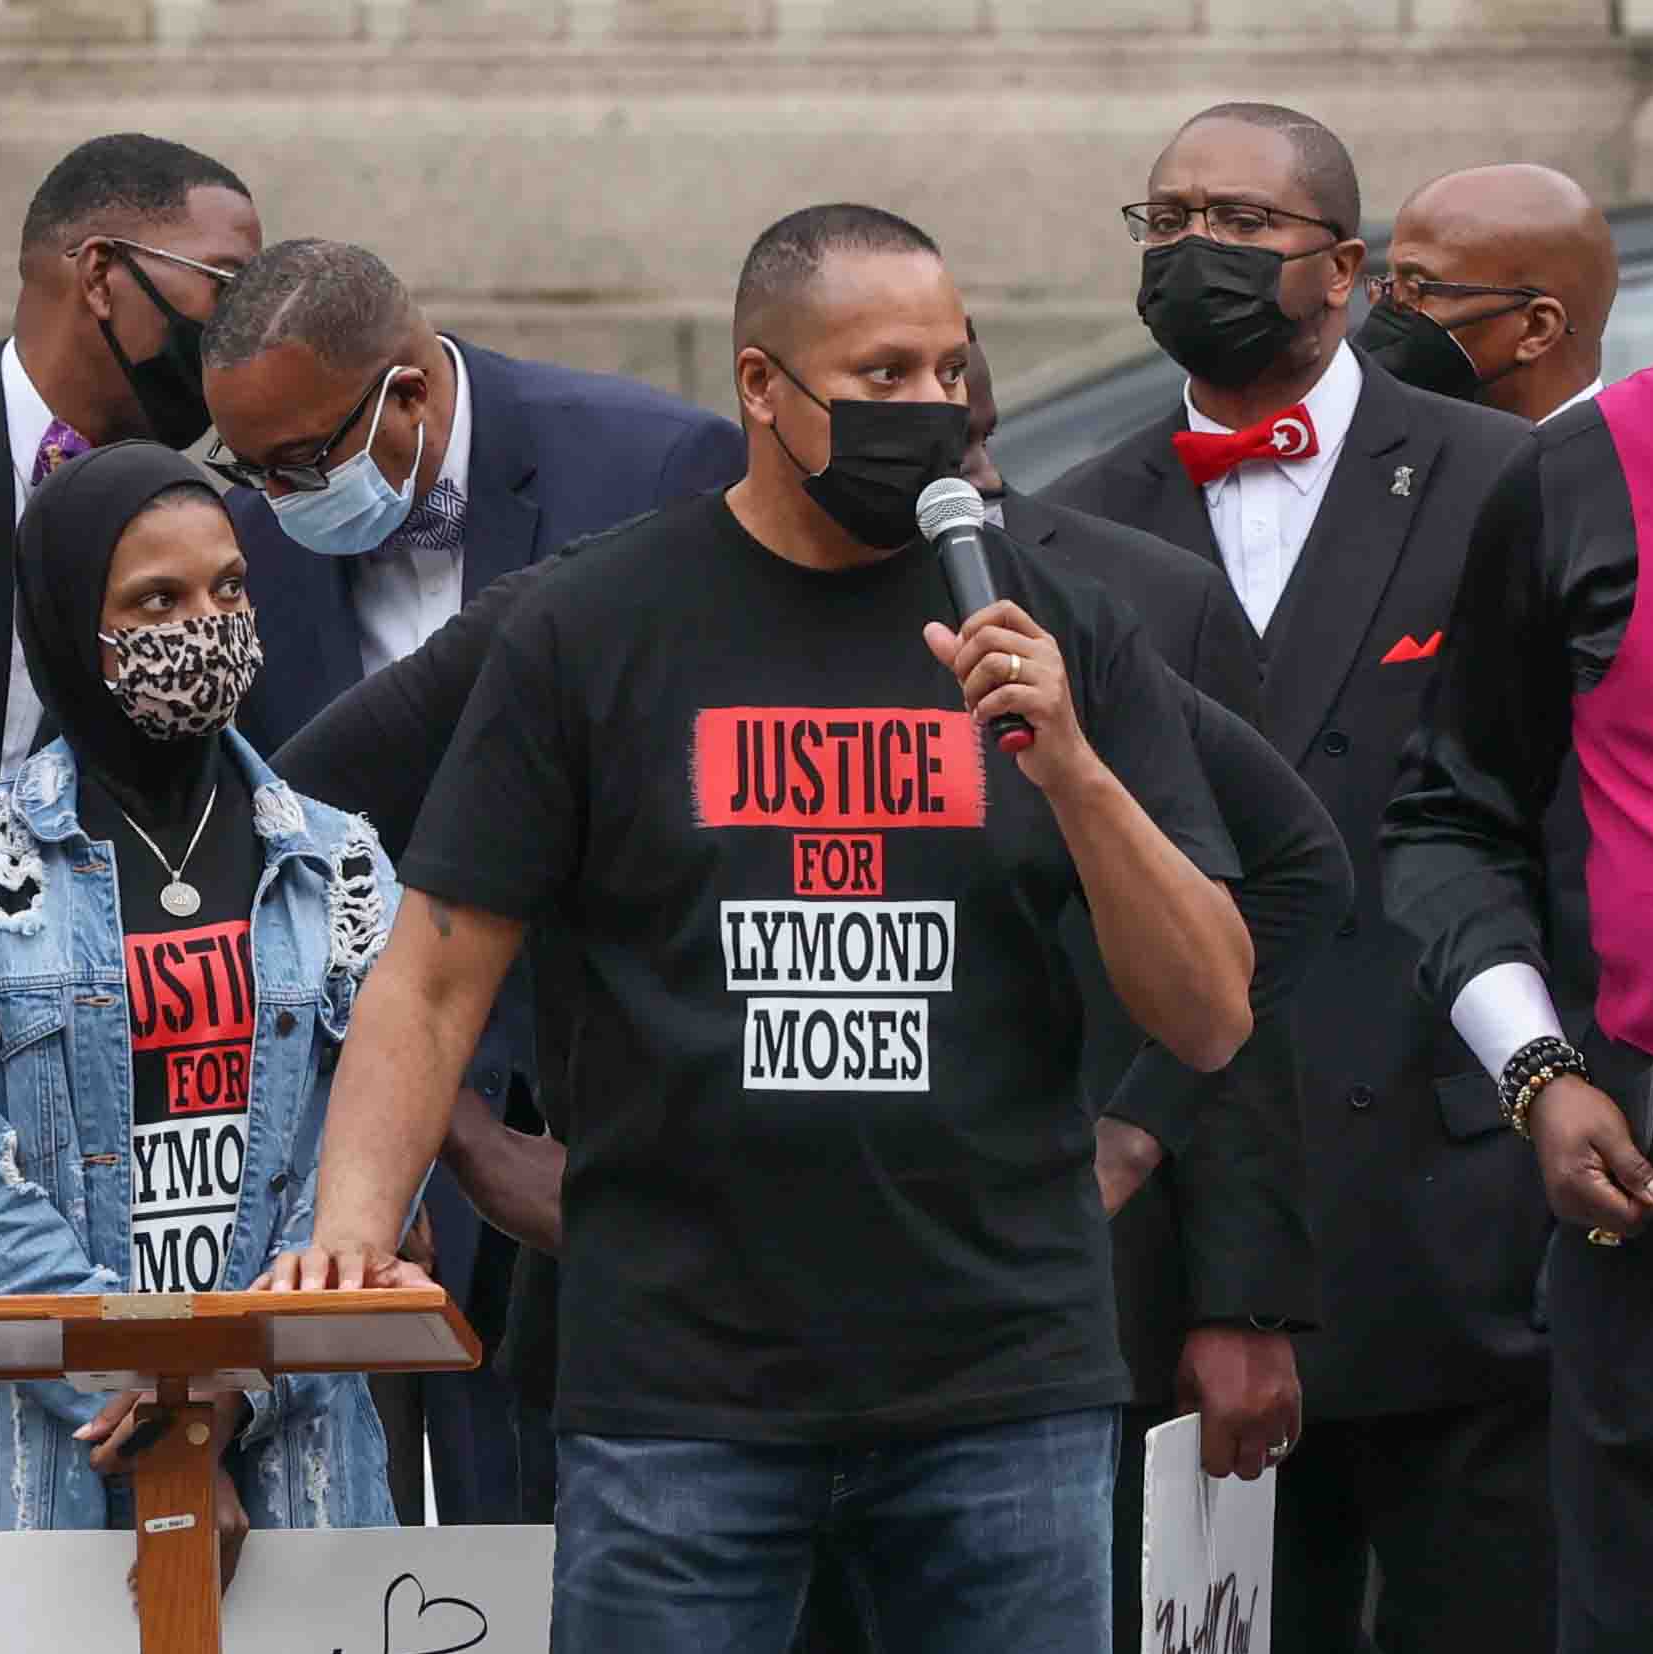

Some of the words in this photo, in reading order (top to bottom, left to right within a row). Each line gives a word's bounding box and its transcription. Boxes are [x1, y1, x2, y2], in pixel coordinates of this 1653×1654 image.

[730, 719, 946, 816] JUSTICE
[799, 839, 877, 891] FOR
[726, 911, 948, 983] LYMOND
[174, 1052, 247, 1108] FOR
[750, 1008, 923, 1081] MOSES
